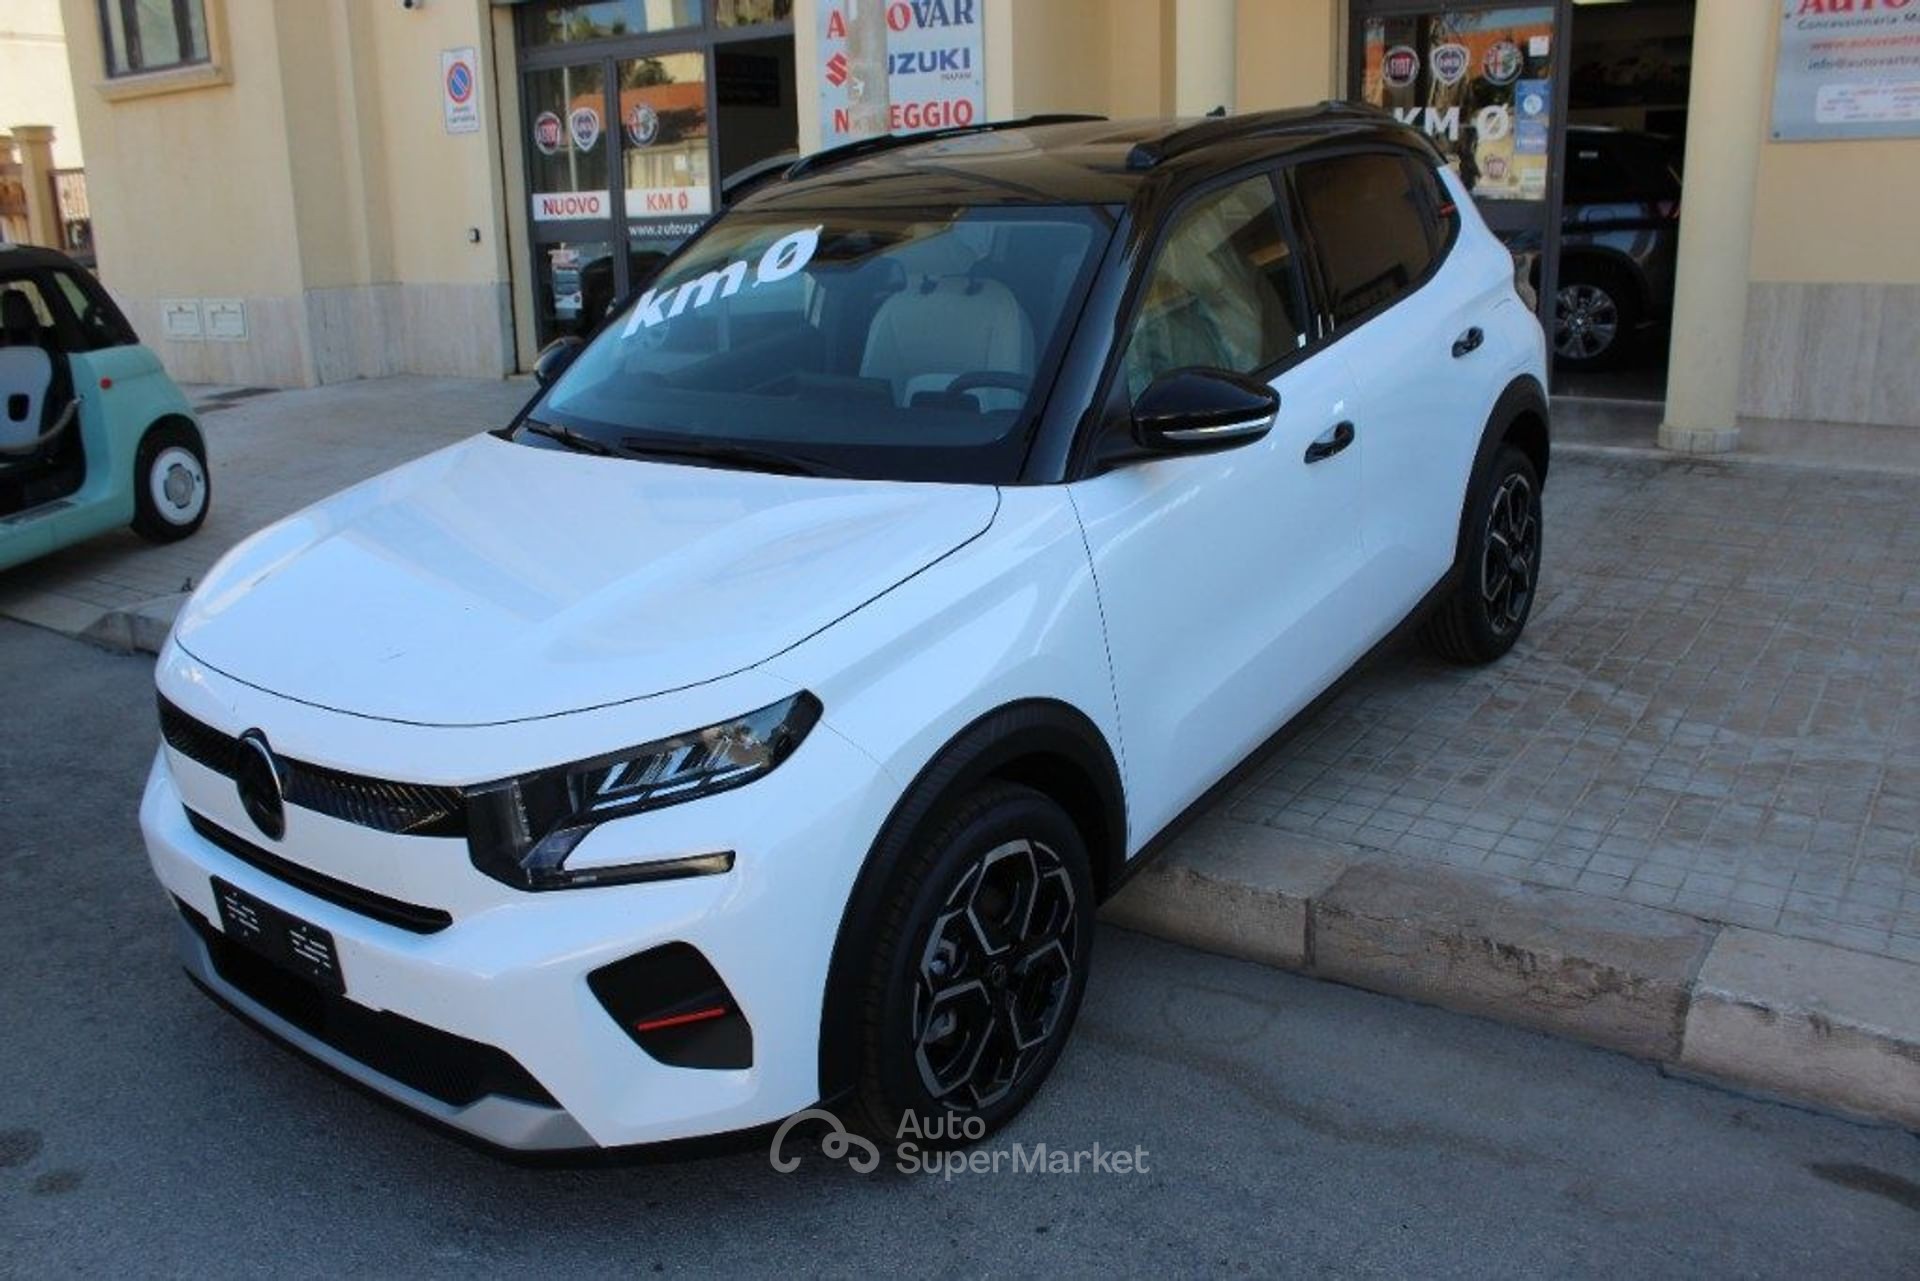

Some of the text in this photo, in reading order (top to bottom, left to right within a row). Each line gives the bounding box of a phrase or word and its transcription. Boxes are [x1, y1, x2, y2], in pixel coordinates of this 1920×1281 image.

[826, 0, 975, 39] AOVAR
[888, 48, 971, 76] ZUKI
[833, 99, 974, 134] NEGGIO
[543, 197, 600, 216] NUOVO
[646, 194, 673, 211] KM
